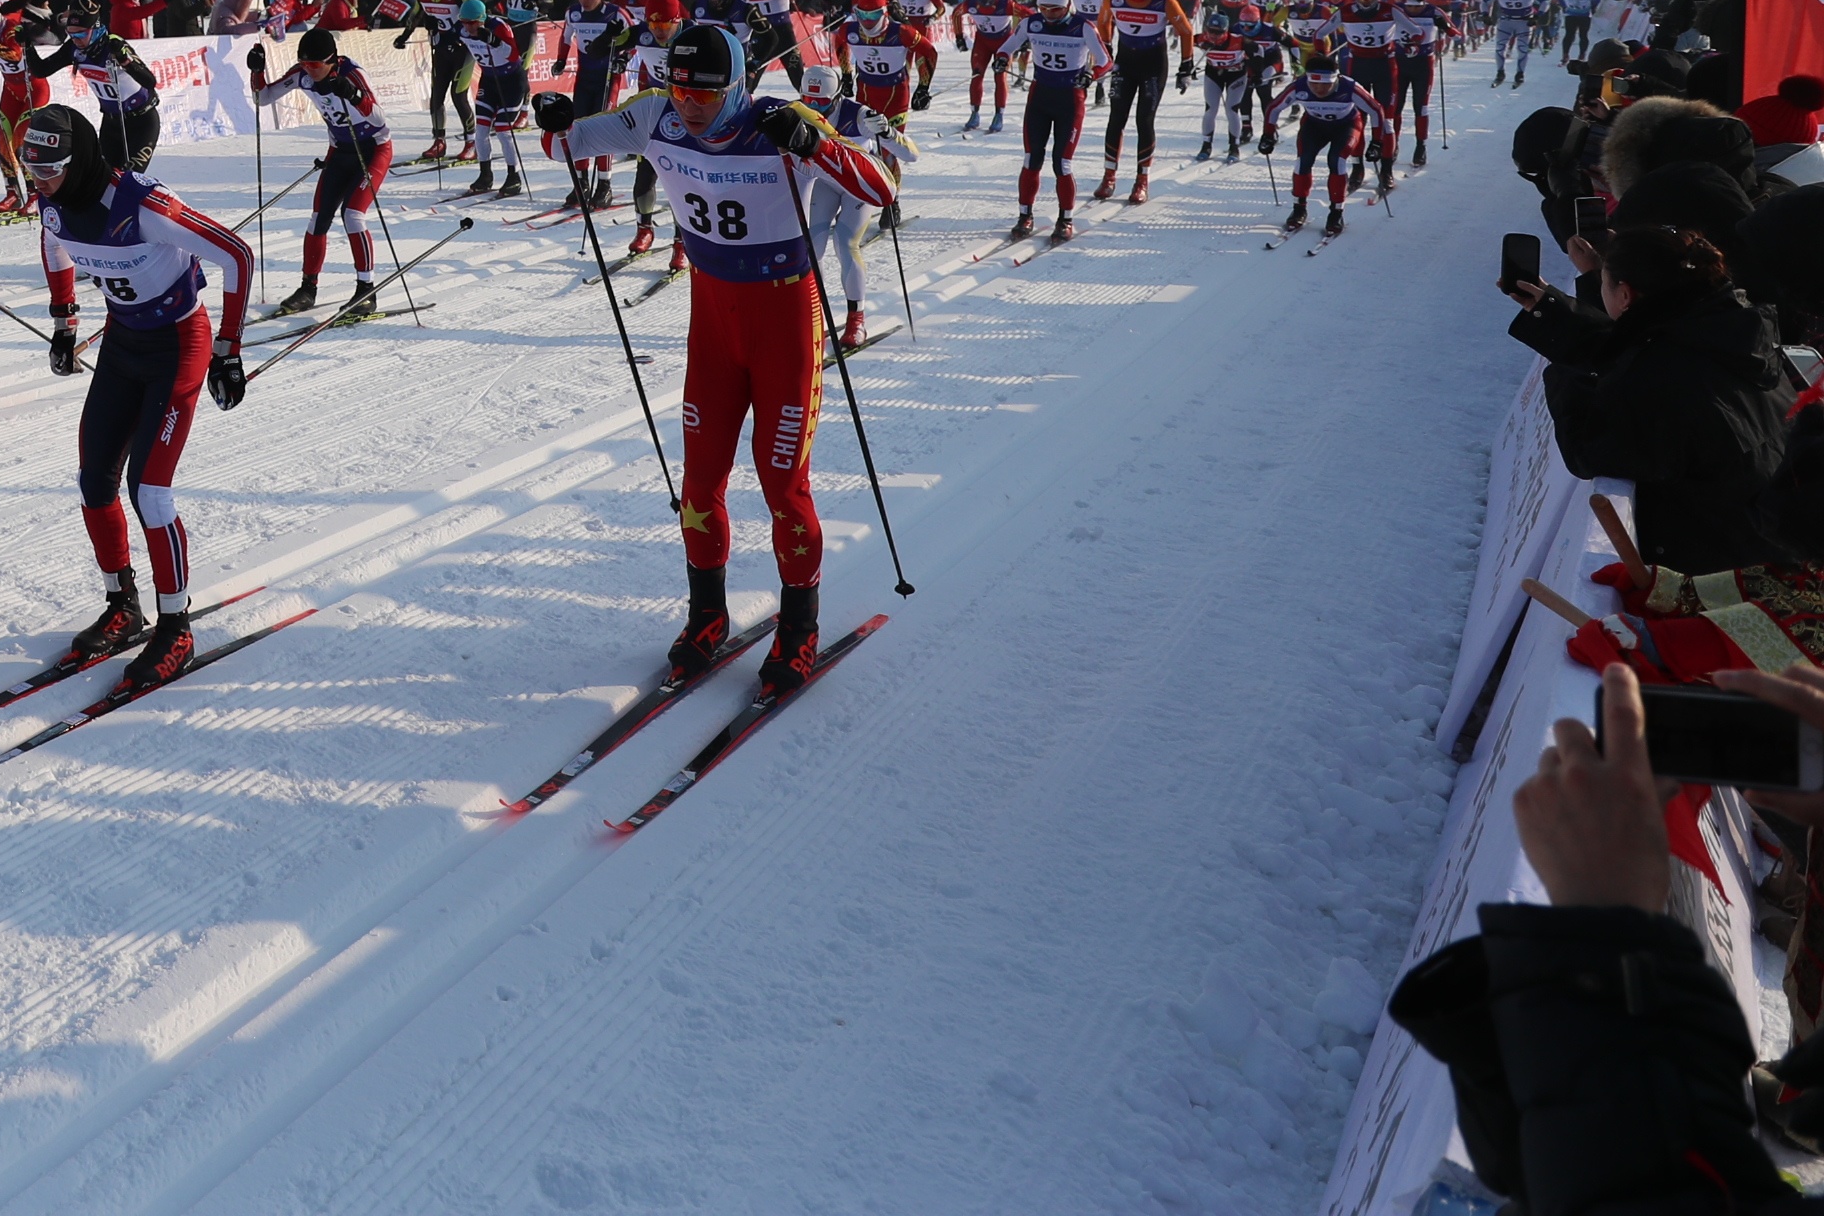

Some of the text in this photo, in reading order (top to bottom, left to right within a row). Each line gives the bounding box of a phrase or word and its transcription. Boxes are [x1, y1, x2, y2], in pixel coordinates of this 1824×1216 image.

[1129, 24, 1142, 34] 7
[863, 60, 890, 75] 50
[1041, 52, 1068, 70] 25
[91, 81, 118, 100] 10
[677, 163, 778, 184] NCI 新华保险
[684, 192, 748, 240] 38
[771, 403, 805, 471] CHINA
